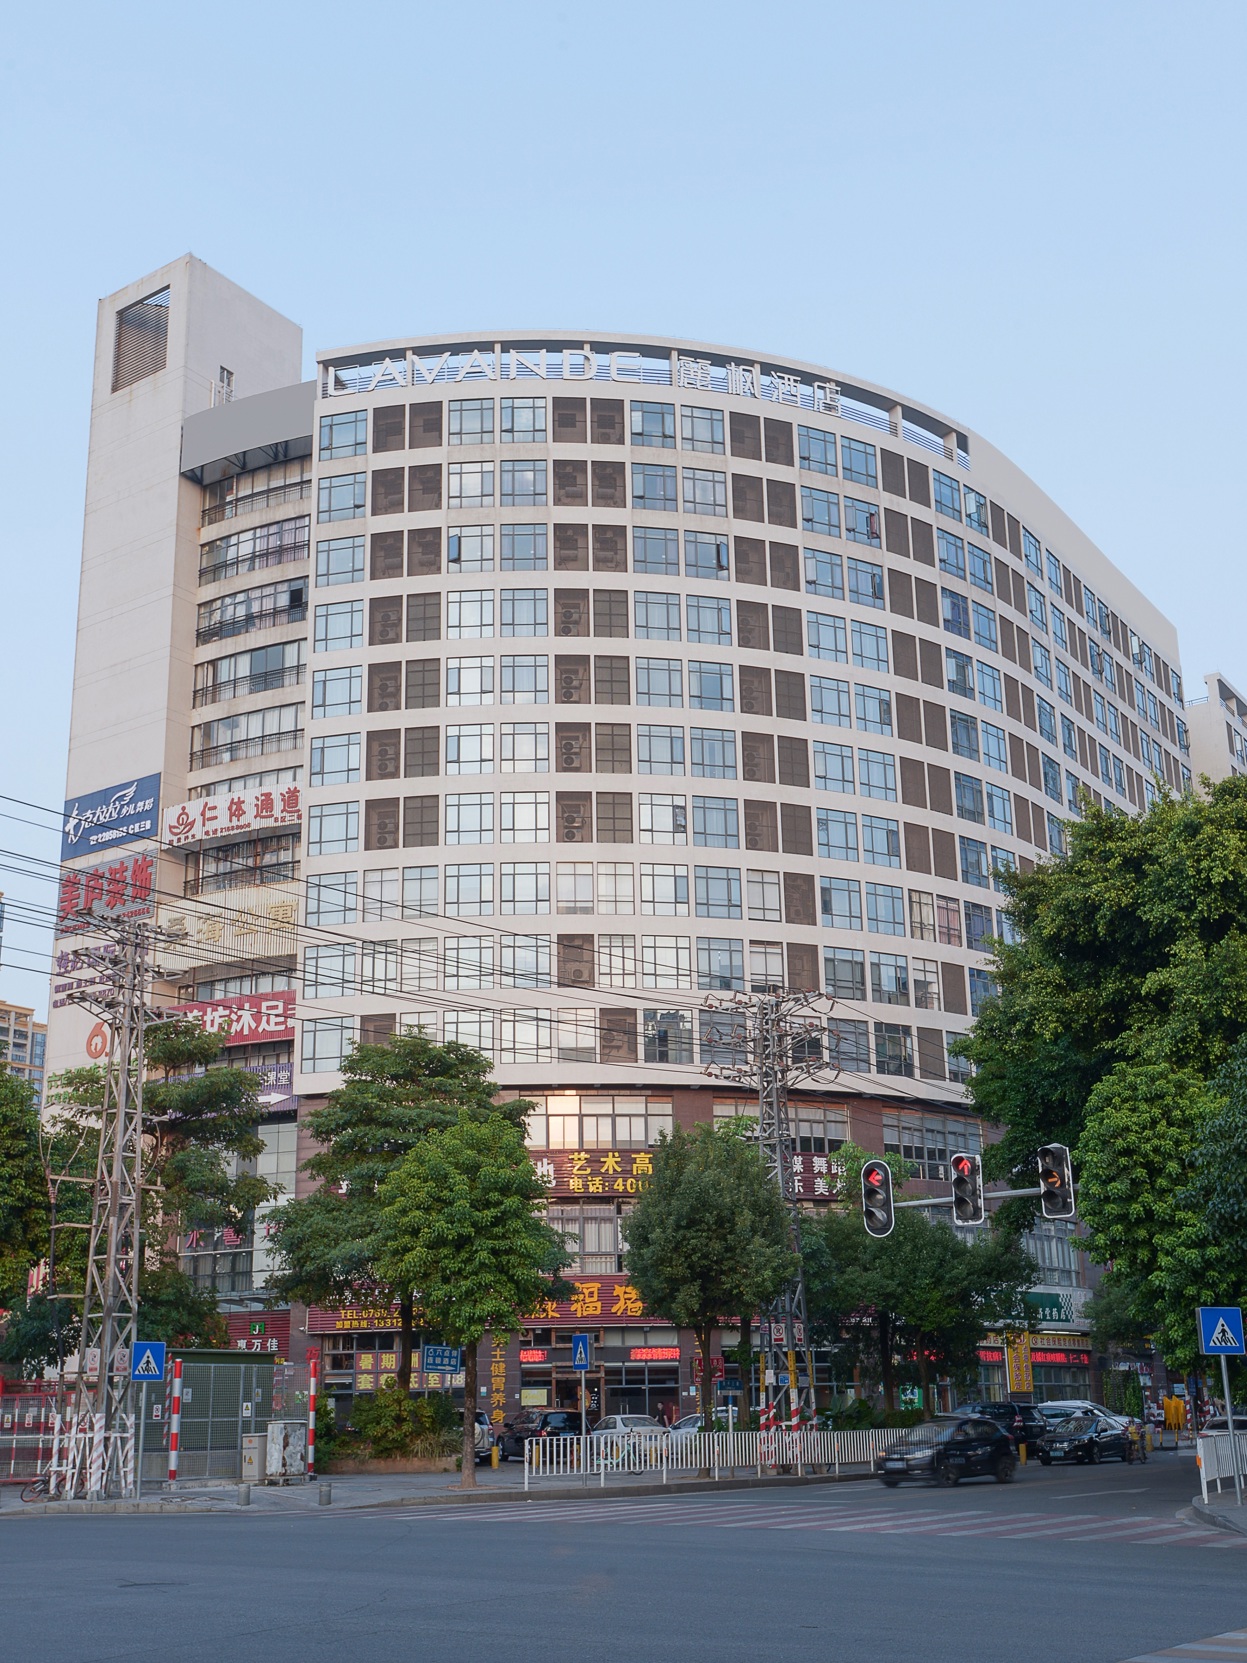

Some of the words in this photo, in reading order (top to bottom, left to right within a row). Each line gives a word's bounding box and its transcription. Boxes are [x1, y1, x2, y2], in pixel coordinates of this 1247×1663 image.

[328, 349, 642, 397] LAVANDE
[200, 786, 302, 827] 仁体通道
